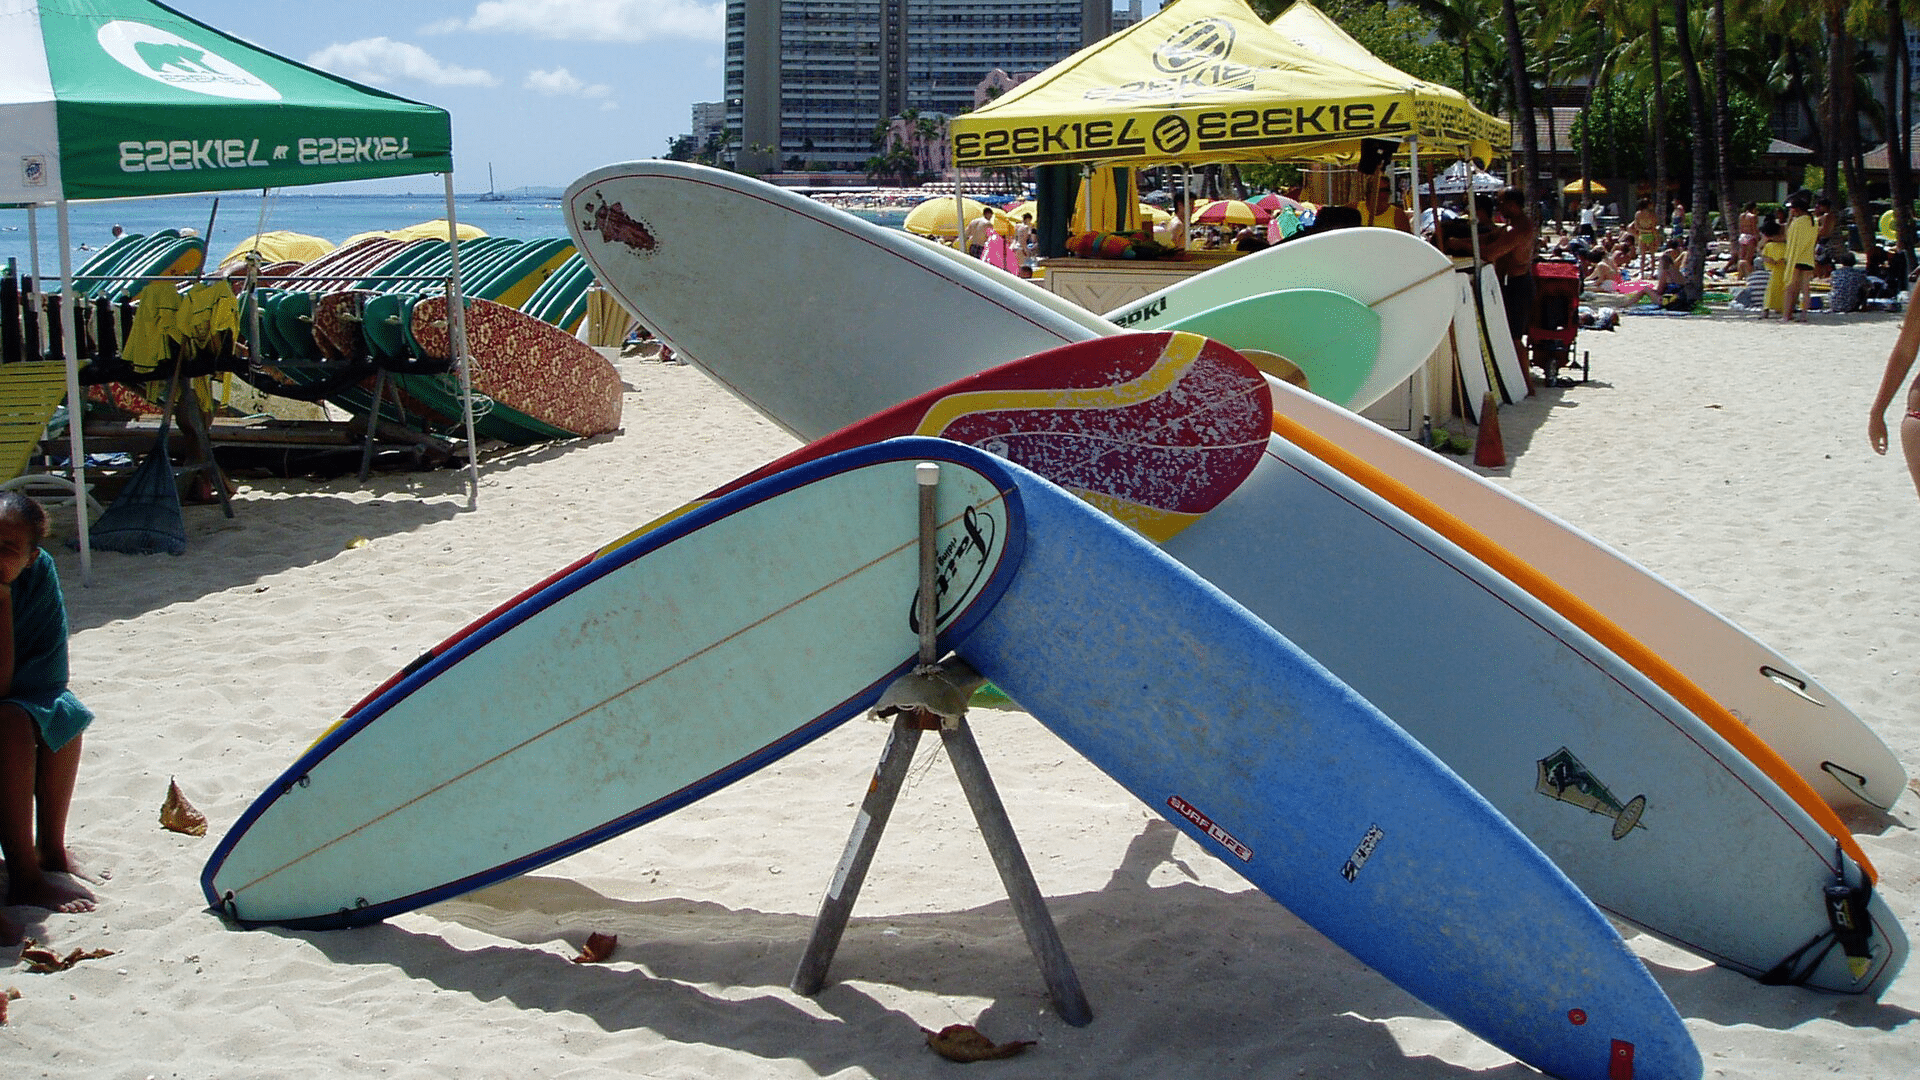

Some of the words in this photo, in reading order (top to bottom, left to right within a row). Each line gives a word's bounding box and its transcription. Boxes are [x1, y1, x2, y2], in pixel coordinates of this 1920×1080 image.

[119, 138, 270, 172] EZEKIEL
[298, 136, 413, 165] EZEKIEL
[955, 118, 1146, 158] EZEKIEL
[1196, 102, 1411, 140] EZEKIEL
[1170, 796, 1211, 828] SURF
[1212, 827, 1247, 857] LIFE
